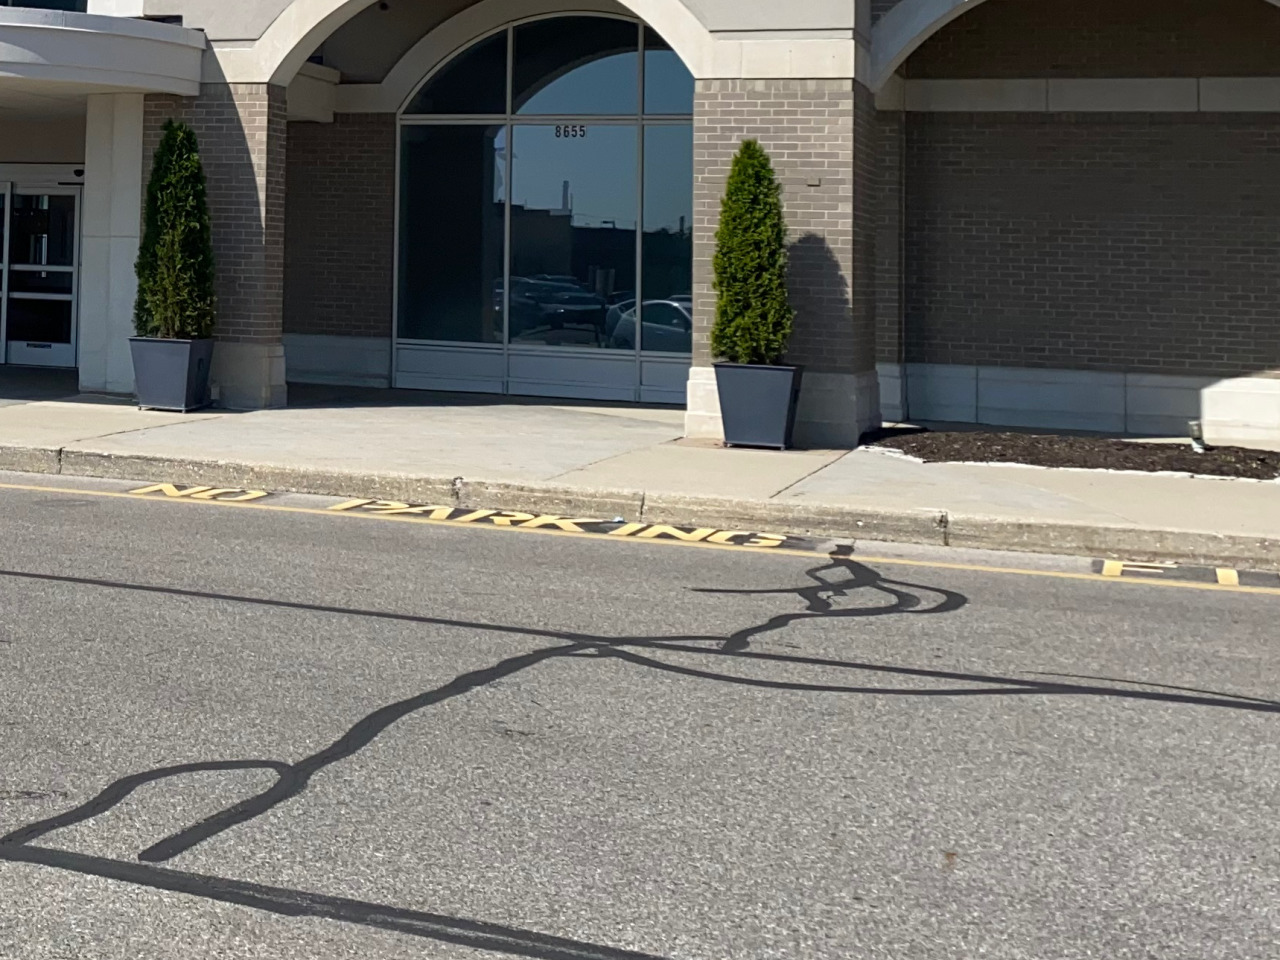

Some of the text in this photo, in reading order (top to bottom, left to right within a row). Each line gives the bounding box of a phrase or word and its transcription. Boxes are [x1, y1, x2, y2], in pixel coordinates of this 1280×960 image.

[554, 124, 586, 138] 8655
[128, 483, 788, 548] NO PARKING
